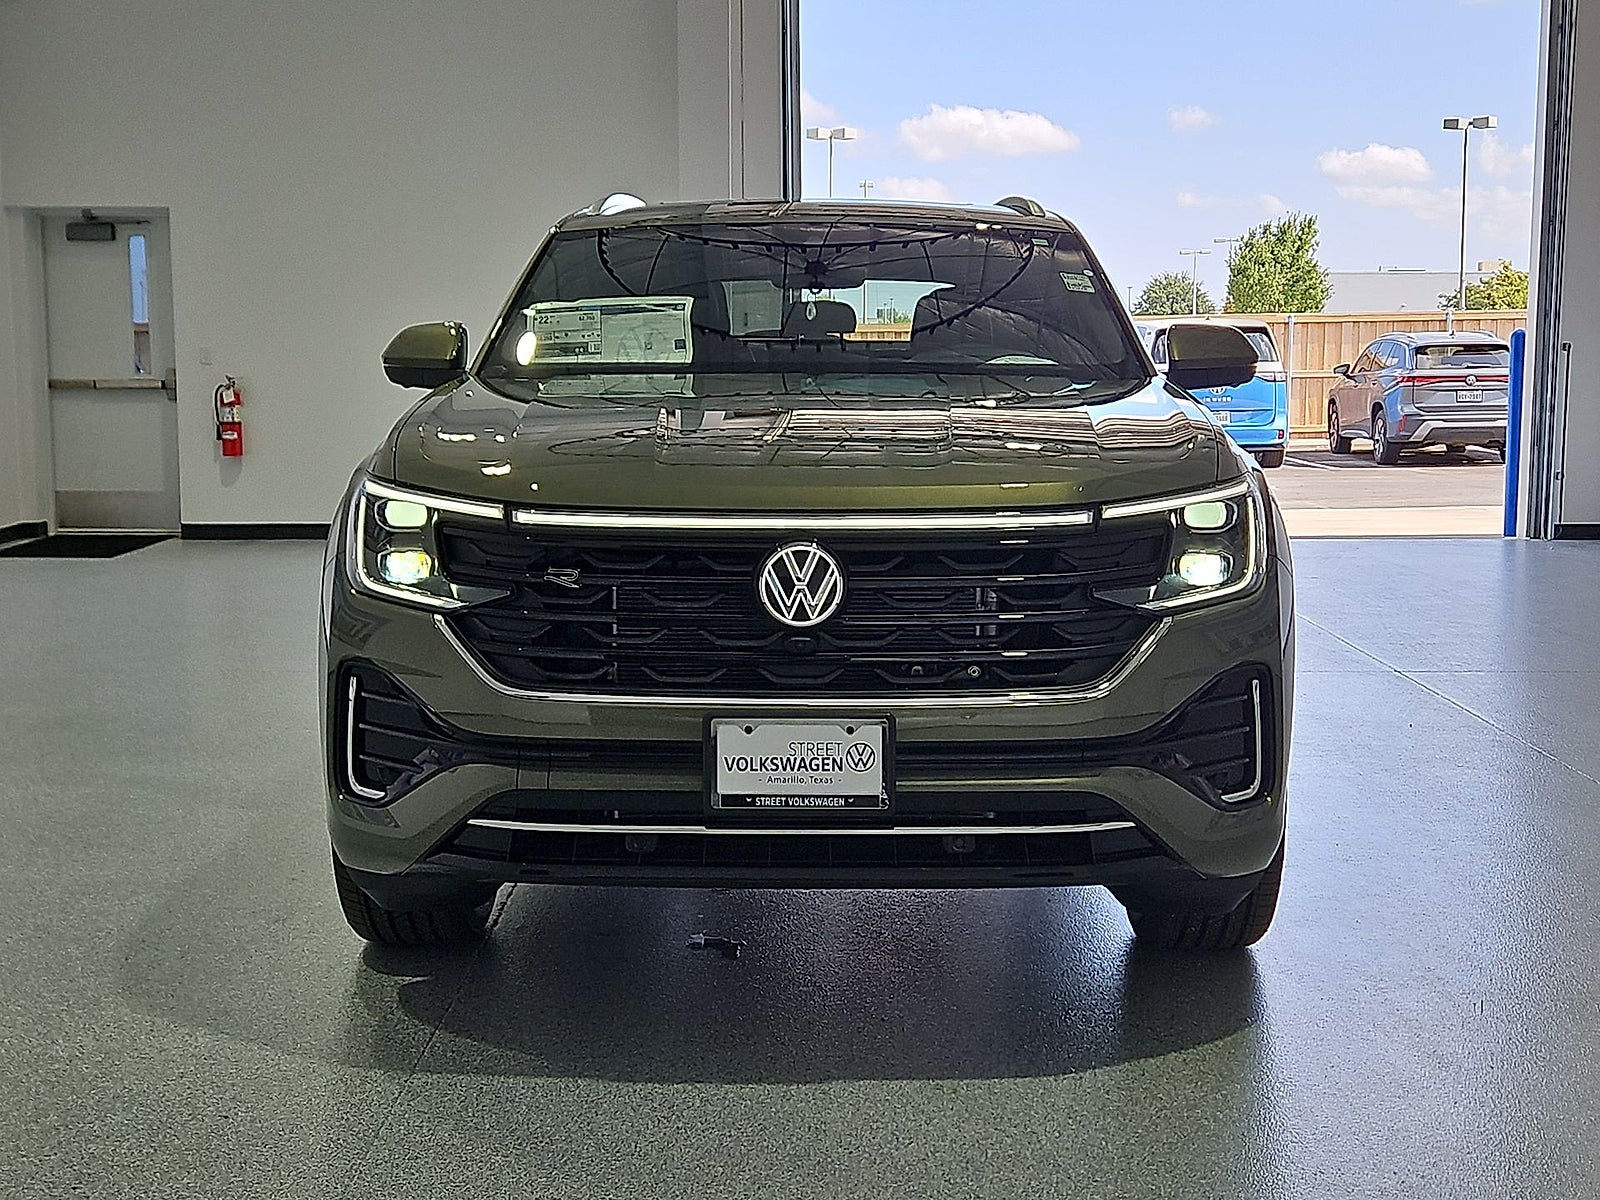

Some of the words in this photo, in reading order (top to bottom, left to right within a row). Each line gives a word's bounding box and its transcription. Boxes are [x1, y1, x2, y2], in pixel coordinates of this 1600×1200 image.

[788, 742, 843, 757] STREET
[724, 757, 844, 772] VOLKSWAGEN
[767, 775, 807, 785] Amarillo,
[809, 775, 834, 785] Texas
[755, 797, 786, 807] STREET
[788, 797, 845, 807] VOLKSWAGEN
